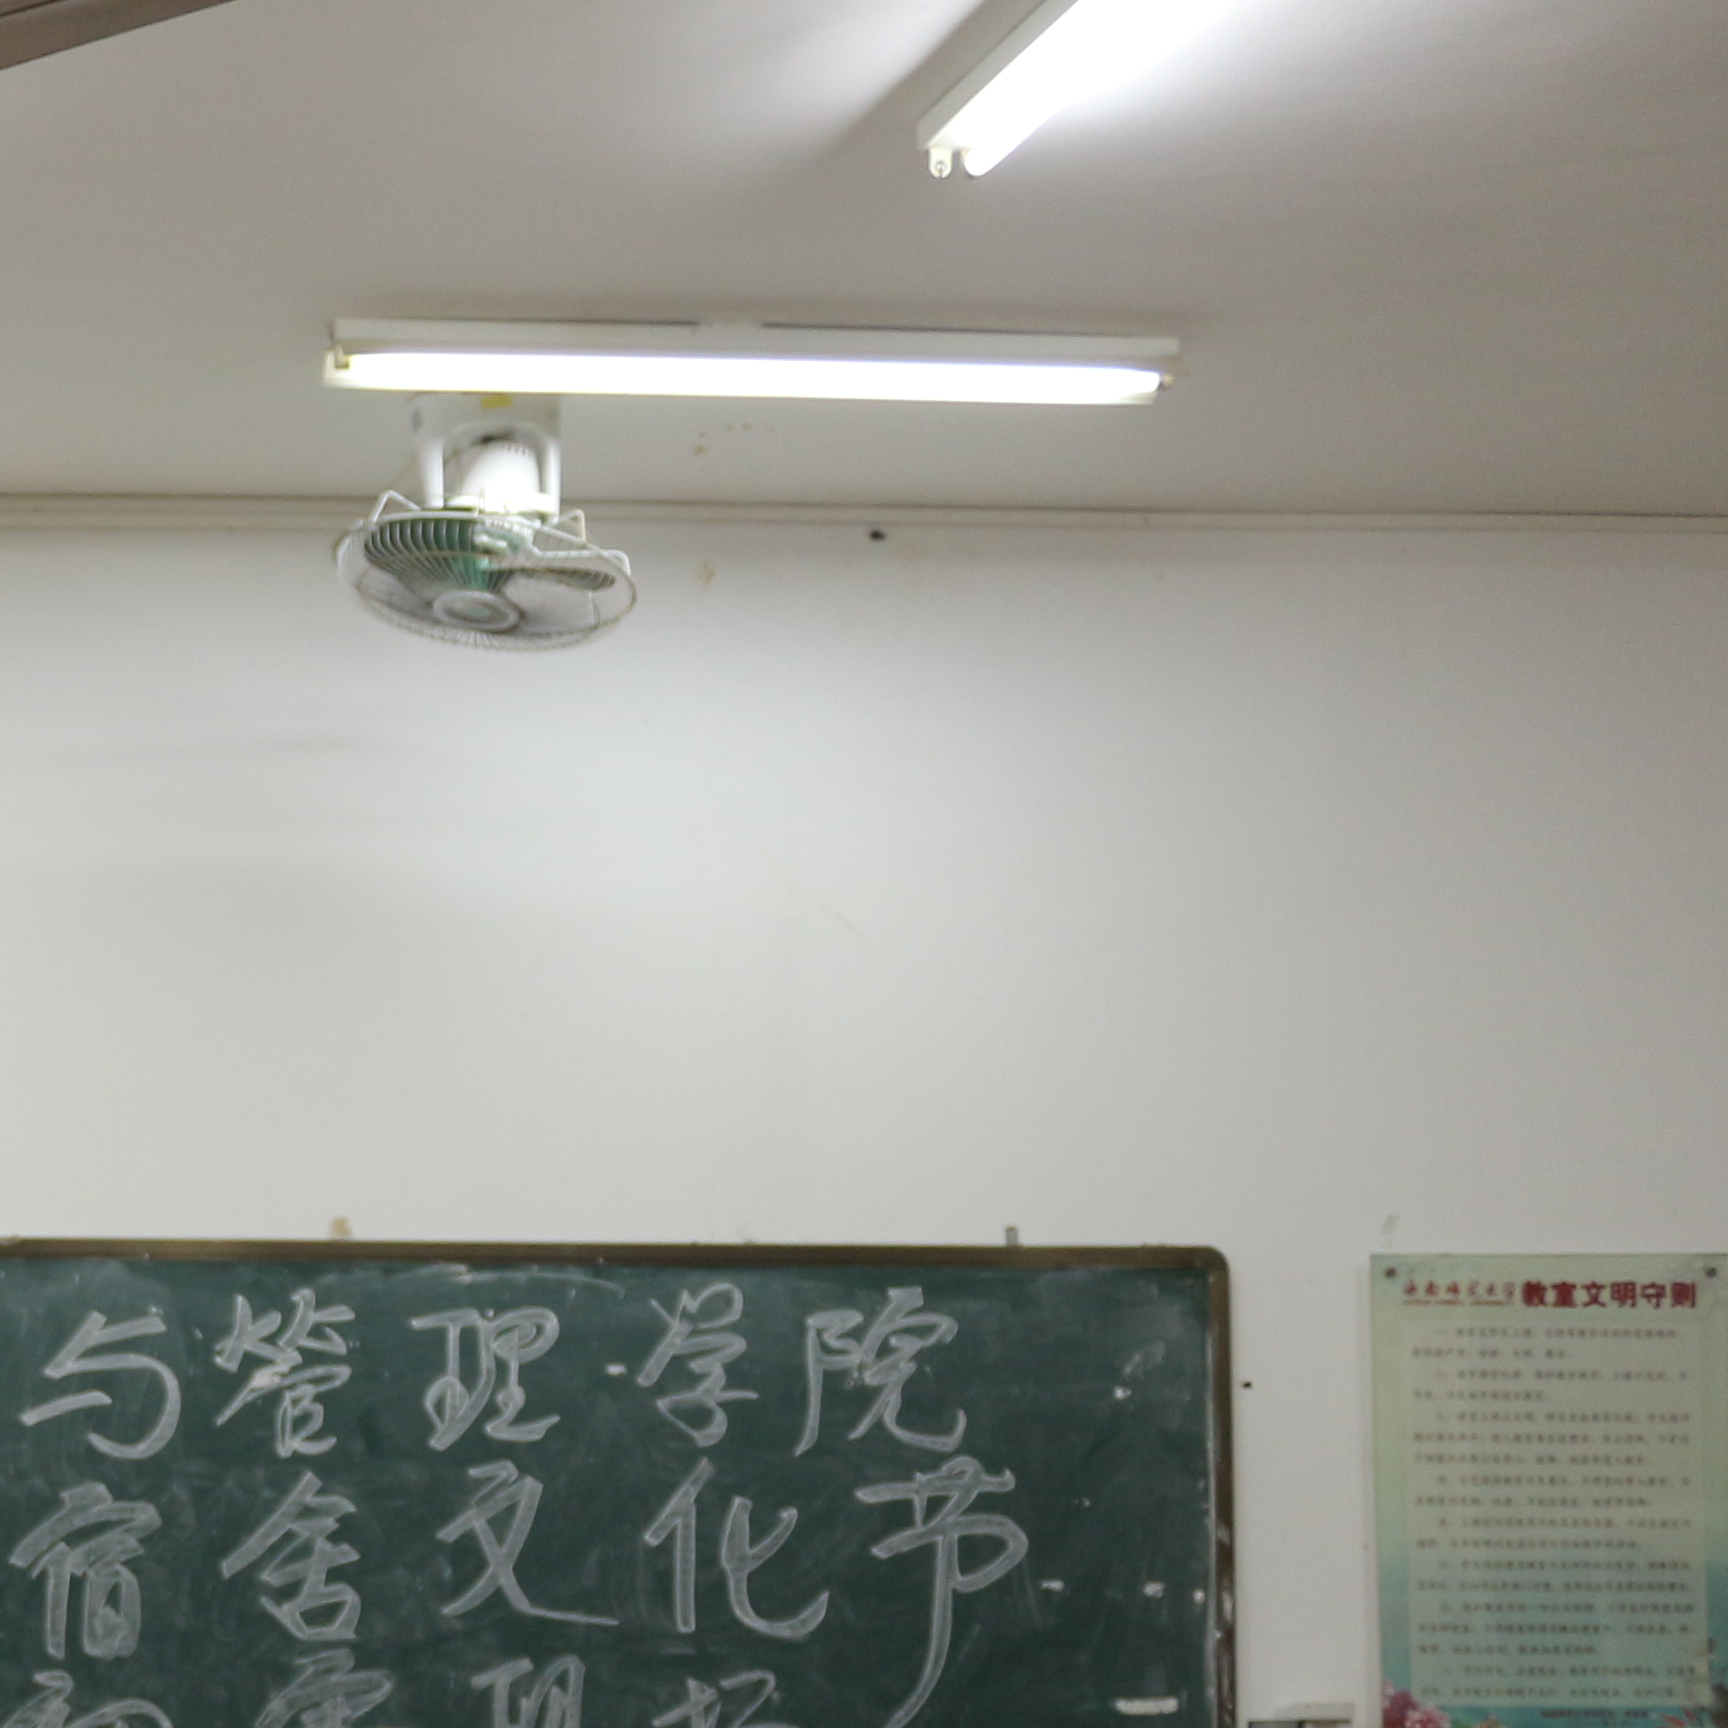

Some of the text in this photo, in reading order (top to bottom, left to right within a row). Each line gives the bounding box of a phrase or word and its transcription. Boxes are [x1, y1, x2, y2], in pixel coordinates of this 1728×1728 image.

[1521, 1280, 1698, 1309] 教室文明守则
